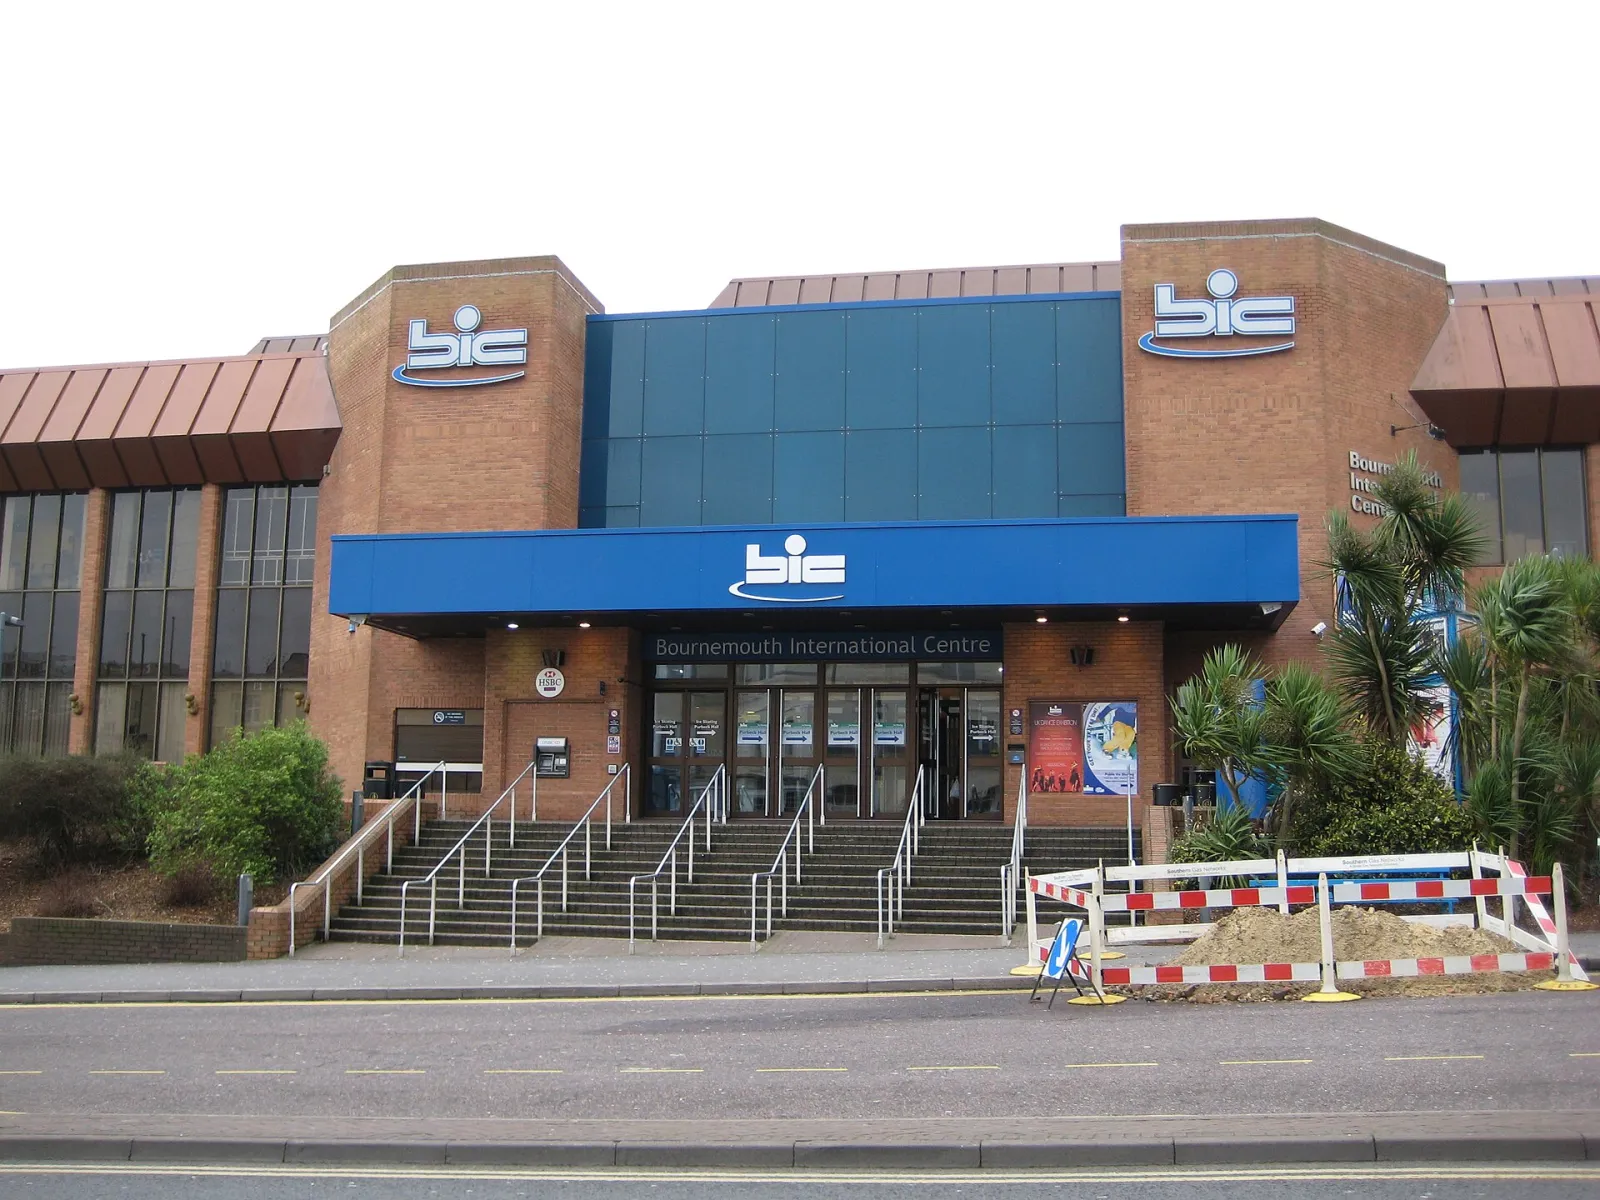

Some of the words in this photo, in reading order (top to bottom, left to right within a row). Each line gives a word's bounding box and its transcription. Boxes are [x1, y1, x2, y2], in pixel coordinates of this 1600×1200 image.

[1154, 268, 1295, 337] bic
[407, 304, 527, 369] bic
[746, 534, 846, 584] bic
[656, 637, 782, 656] Bournemouth
[790, 635, 916, 655] International
[923, 635, 991, 653] Centre
[539, 678, 561, 687] HSBC
